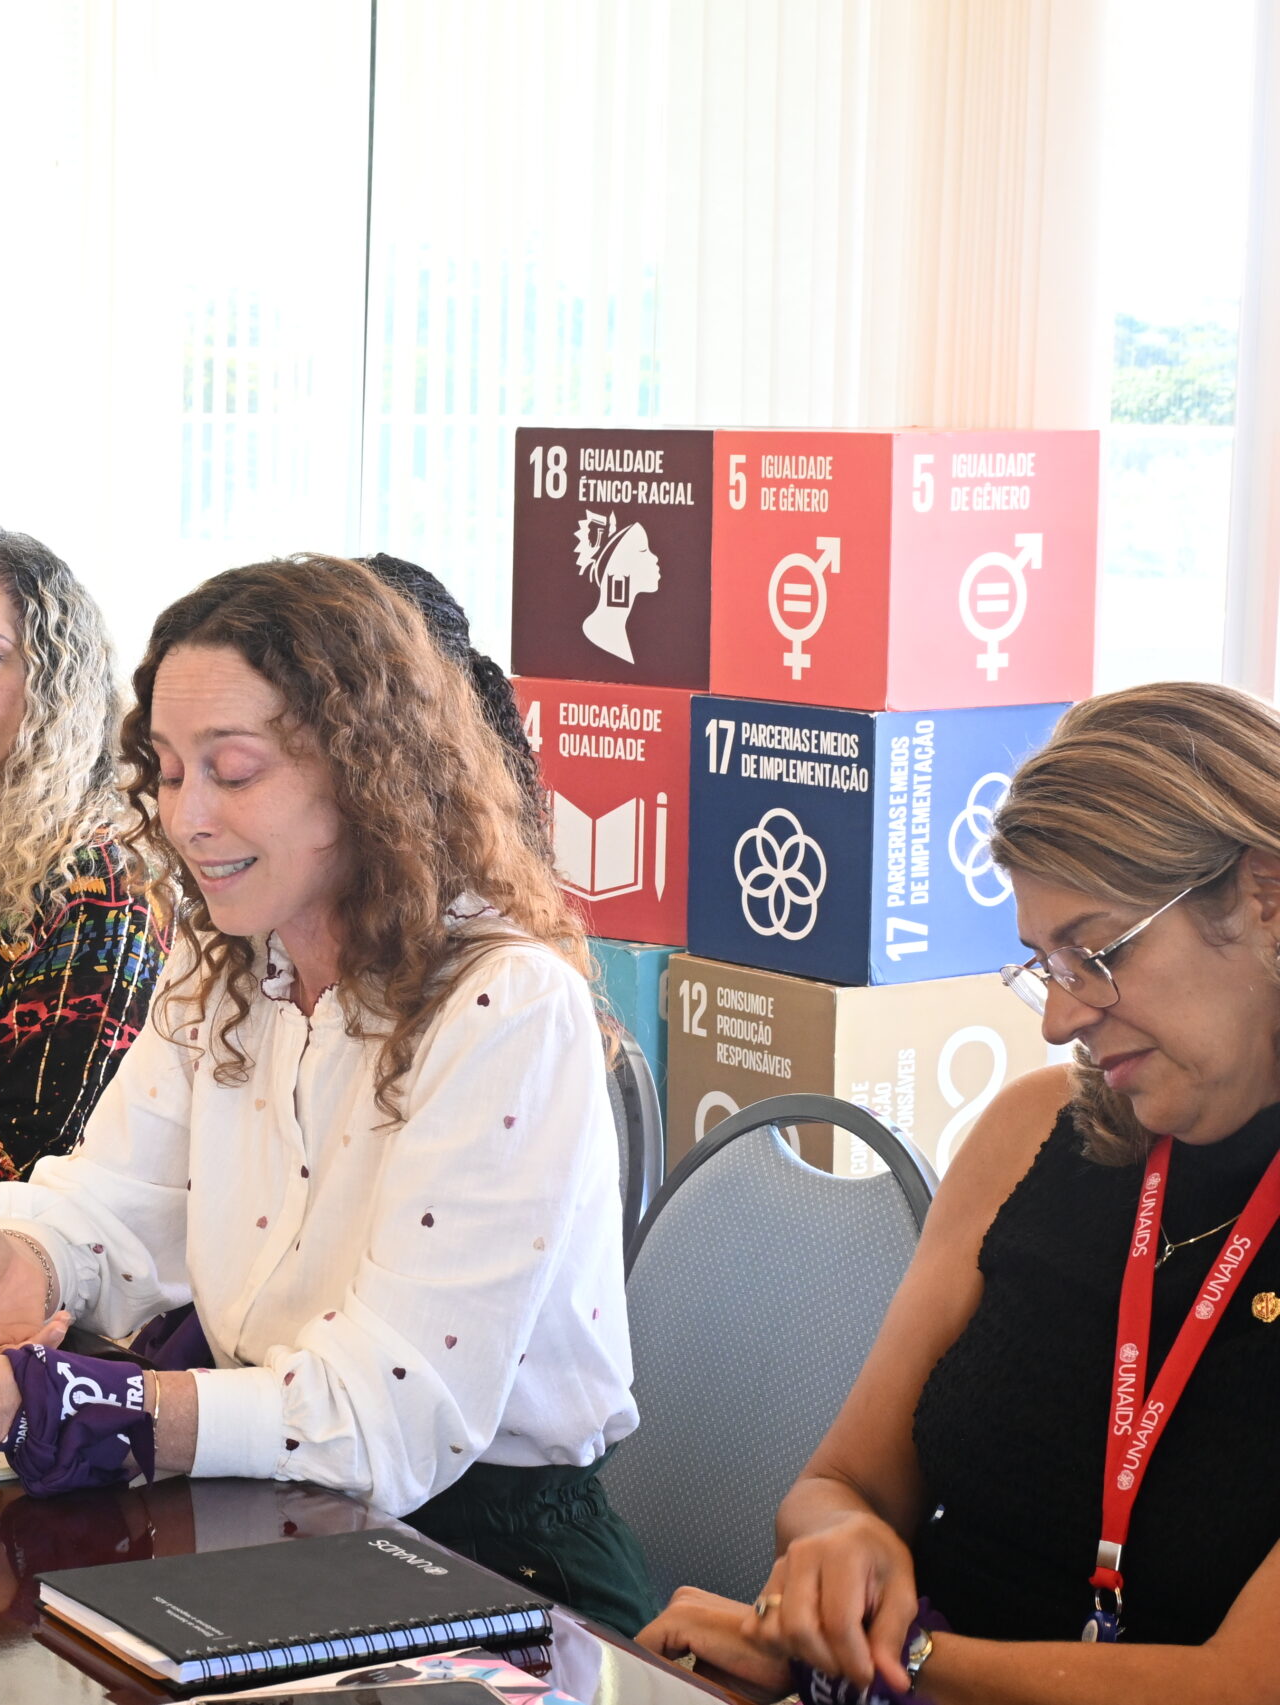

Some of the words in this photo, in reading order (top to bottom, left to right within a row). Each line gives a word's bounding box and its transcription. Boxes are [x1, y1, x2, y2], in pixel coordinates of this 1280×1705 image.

[529, 446, 568, 499] 18
[579, 448, 664, 474] IGUALDADE
[761, 455, 833, 480] IGUALDADE
[951, 452, 1036, 478] IGUALDADE
[578, 476, 695, 505] ÉTNICO-RACIAL
[729, 454, 746, 510] 5
[761, 487, 776, 511] DE
[779, 484, 829, 513] GÊNERO
[912, 453, 935, 512] 5
[950, 486, 970, 511] DE
[972, 482, 1031, 511] GÊNERO
[523, 701, 543, 752] 4
[559, 702, 641, 732] EDUCAÇÃO
[643, 709, 662, 732] DE
[559, 733, 646, 762] QUALIDADE
[705, 718, 736, 774] 17
[741, 722, 810, 753] PARCERIAS
[811, 730, 819, 753] E
[820, 731, 859, 758] MEIOS
[741, 753, 758, 778] DE
[760, 756, 869, 793] IMPLEMENTAÇÃO
[890, 736, 910, 793] MEIOS
[889, 793, 907, 805] E
[911, 720, 935, 878] IMPLEMENTAÇÃO
[887, 805, 907, 907] PARCERIAS
[910, 880, 929, 905] DE
[886, 917, 929, 962] 17
[679, 979, 708, 1038] 12
[716, 986, 767, 1016] CONSUMO
[767, 997, 775, 1019] E
[716, 1014, 772, 1046] PRODUÇÃO
[716, 1042, 792, 1080] RESPONSÁVEIS
[852, 1080, 870, 1092] E
[1132, 1190, 1159, 1257] UNAIDS
[1202, 1234, 1252, 1302] UNAIDS
[1113, 1364, 1137, 1437] UNAIDS
[1123, 1400, 1165, 1471] UNAIDS
[368, 1540, 433, 1569] UNAIDS
